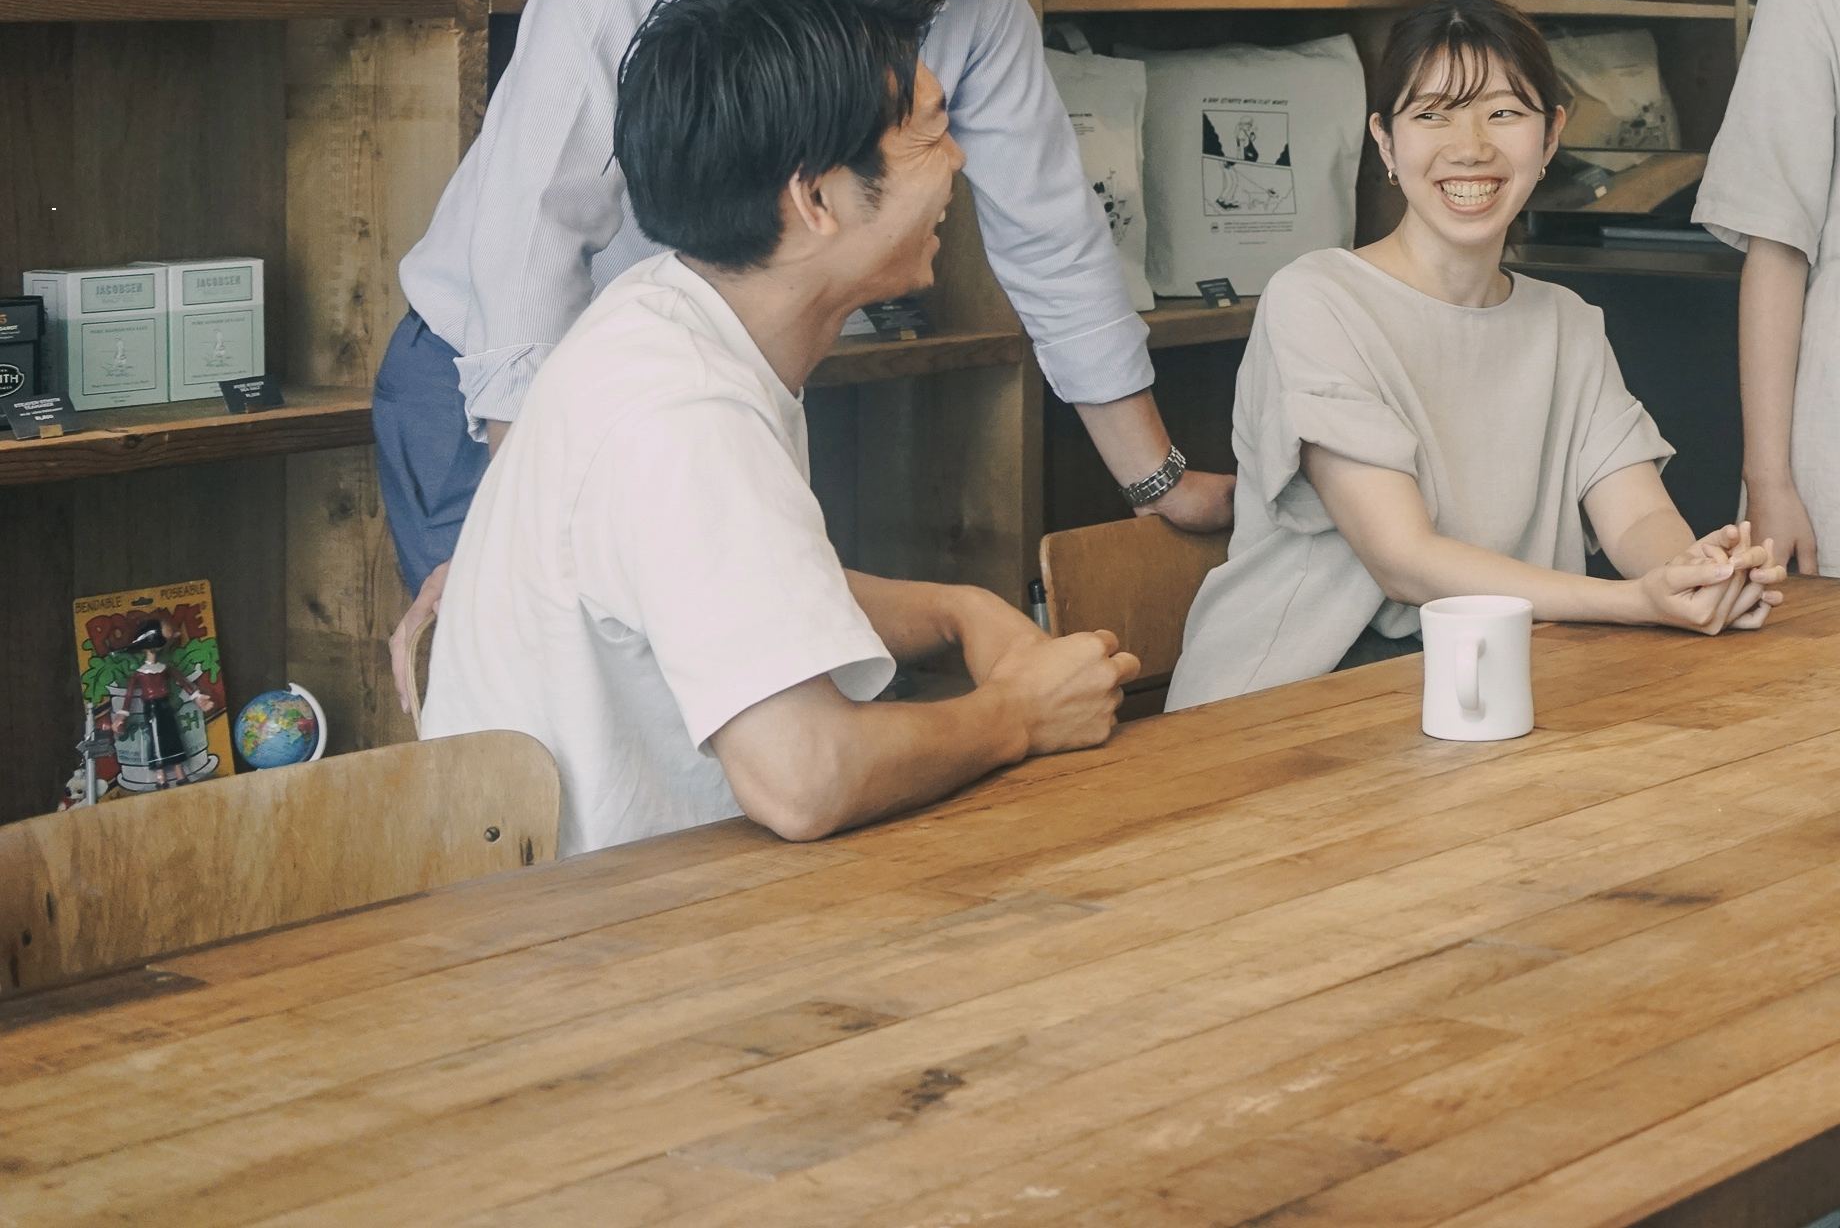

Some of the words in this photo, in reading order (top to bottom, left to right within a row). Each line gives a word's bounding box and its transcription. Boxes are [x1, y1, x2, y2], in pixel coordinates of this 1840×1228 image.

[196, 275, 241, 288] JACOBSEN
[95, 282, 143, 295] JACOBSEN
[75, 597, 122, 612] BENDABLE
[160, 583, 205, 602] POSEABLE
